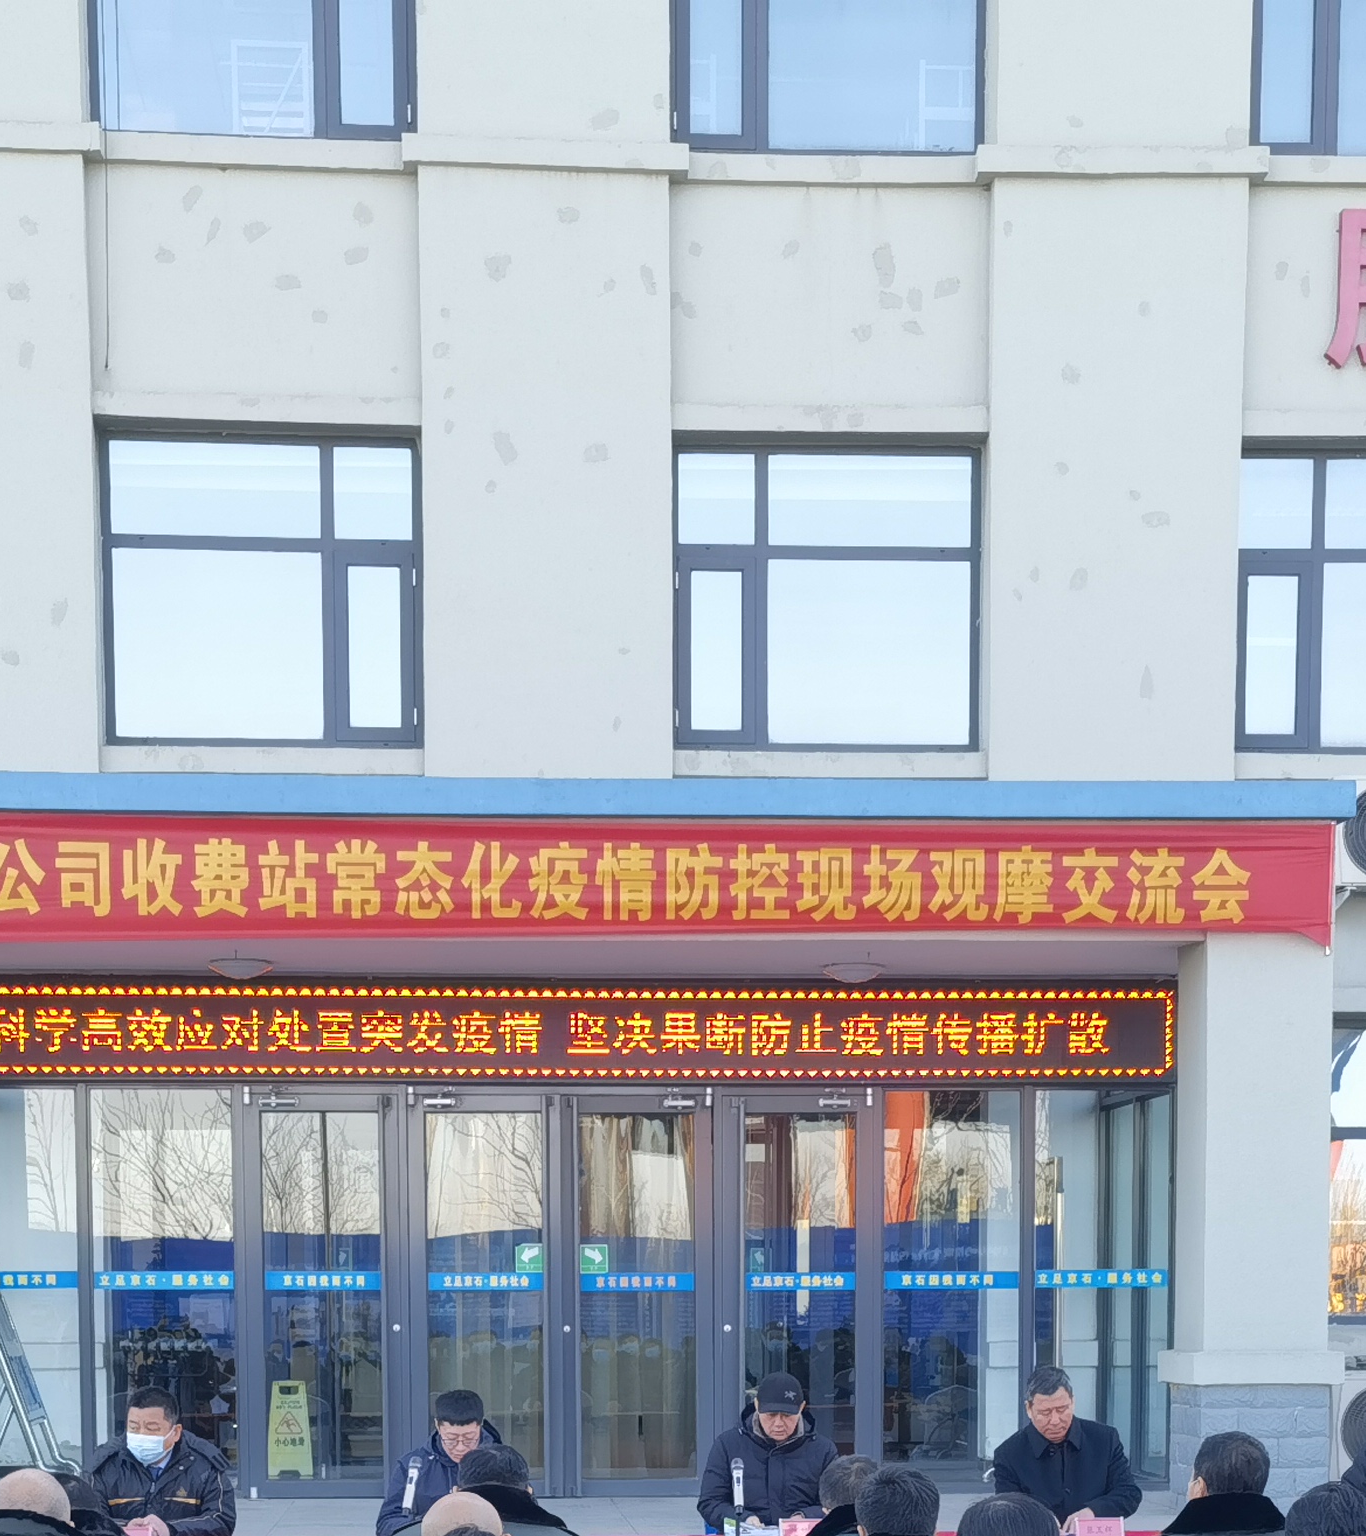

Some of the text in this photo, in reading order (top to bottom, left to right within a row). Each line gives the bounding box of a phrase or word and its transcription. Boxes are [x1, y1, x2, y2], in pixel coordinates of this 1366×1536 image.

[566, 1010, 1110, 1057] 坚决果断防止疫情传播扩散
